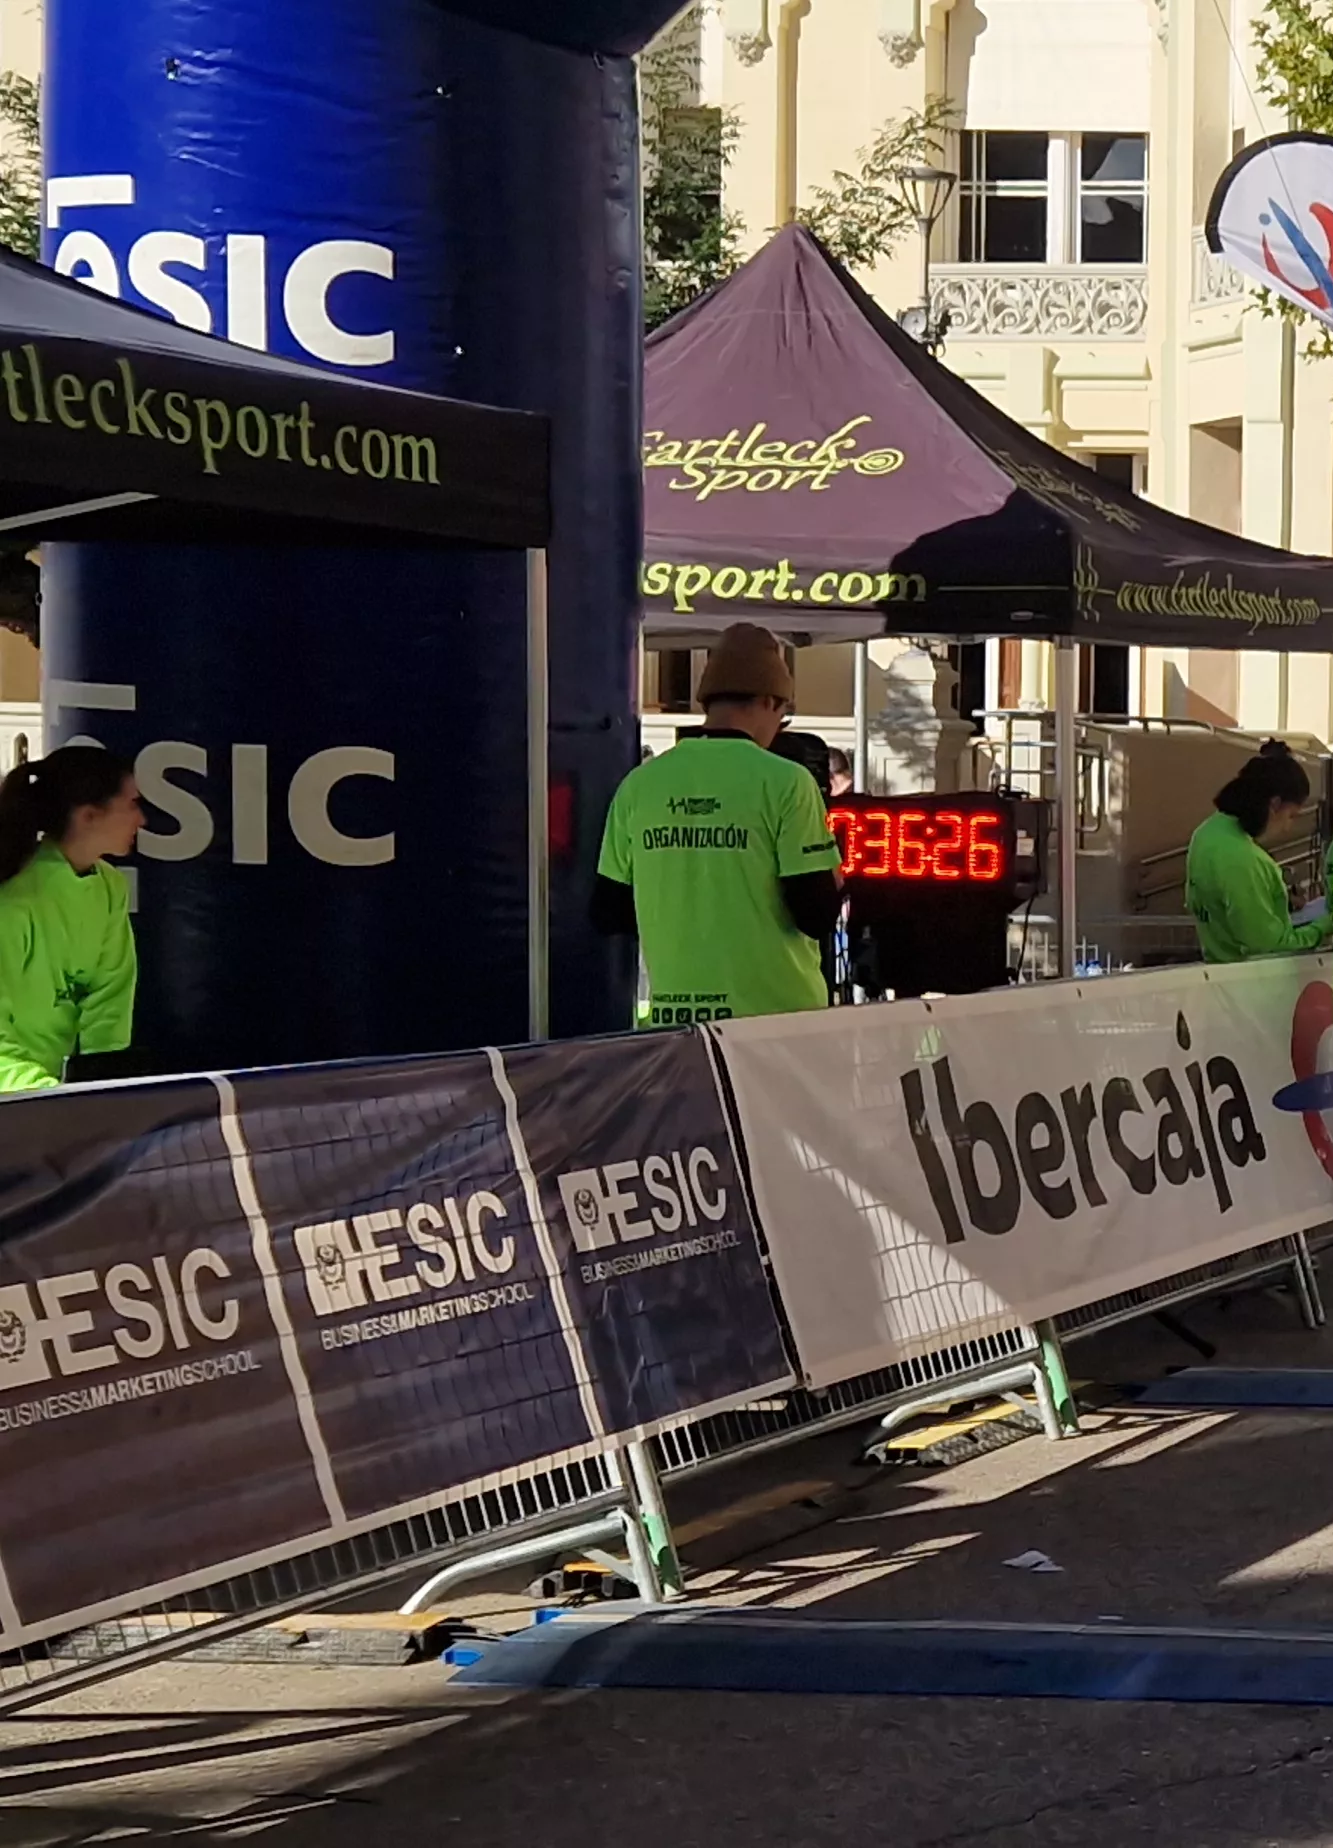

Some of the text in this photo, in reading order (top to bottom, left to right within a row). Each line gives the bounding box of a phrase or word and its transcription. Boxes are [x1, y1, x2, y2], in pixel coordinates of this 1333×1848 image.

[669, 456, 841, 501] Sport
[640, 558, 926, 613] sport.com
[60, 735, 396, 867] SIC
[643, 823, 748, 850] ORGANIZACIÓN
[900, 1010, 1266, 1244] Ibercaja
[603, 1147, 727, 1242] ESIC
[352, 1191, 515, 1302] ESIC
[37, 1248, 240, 1376] ESIC
